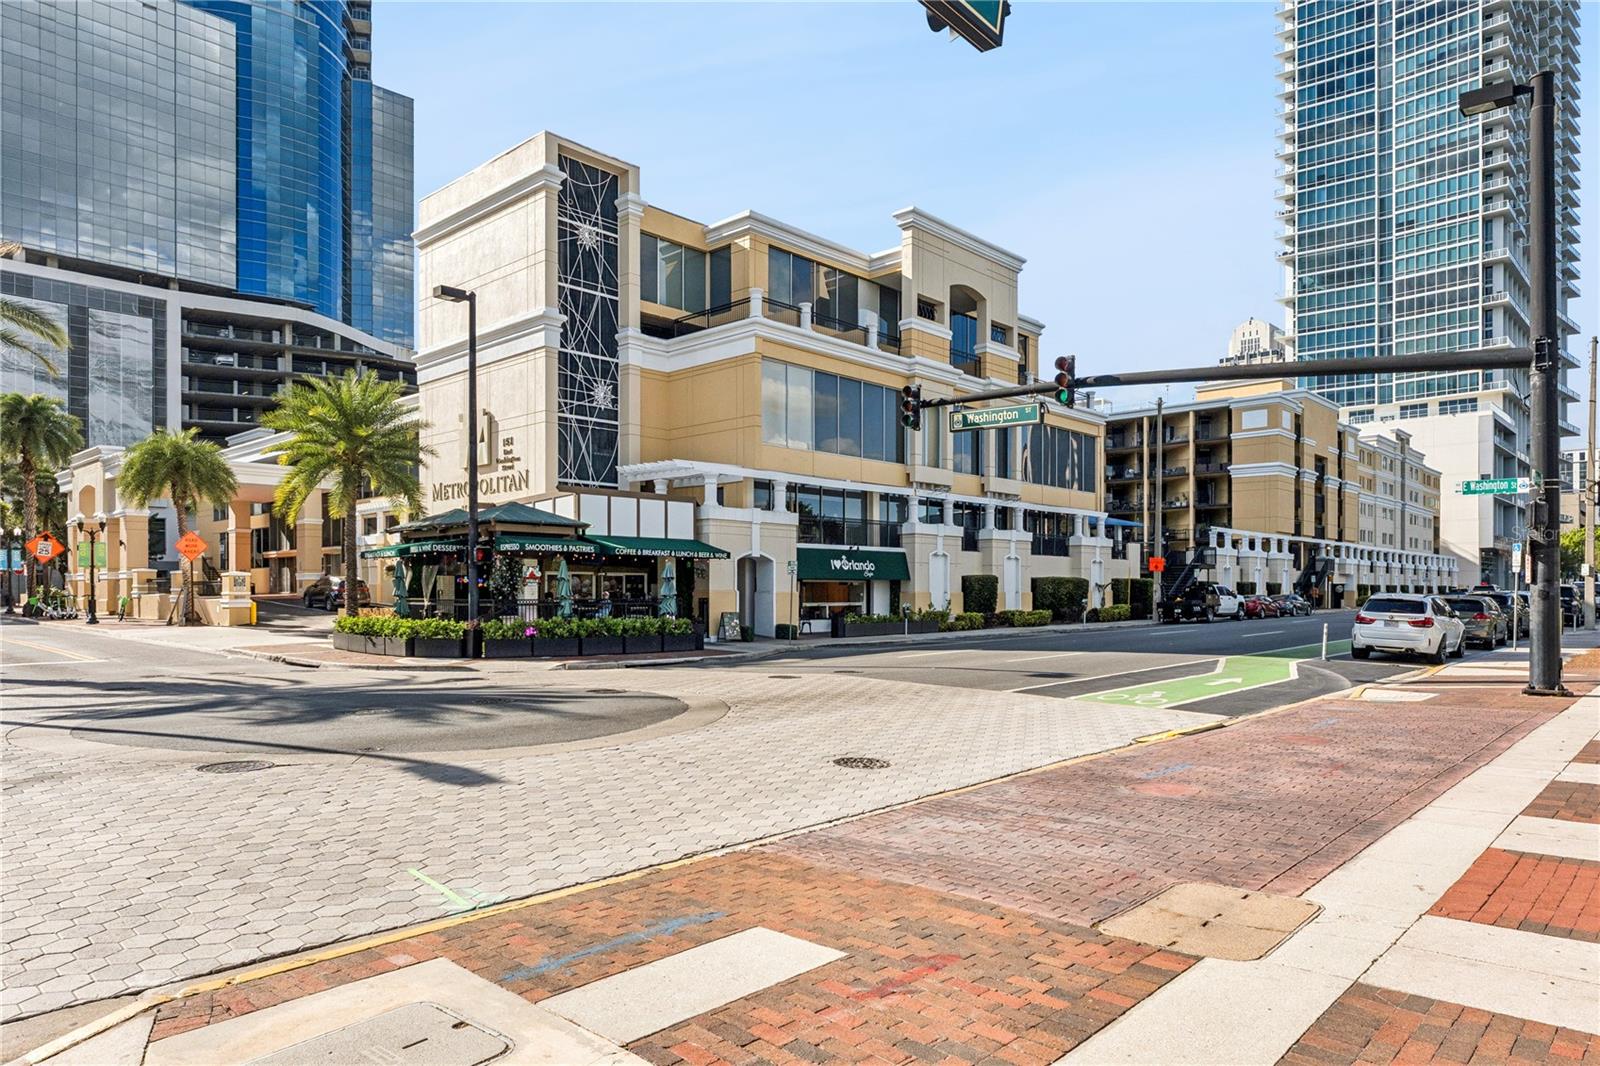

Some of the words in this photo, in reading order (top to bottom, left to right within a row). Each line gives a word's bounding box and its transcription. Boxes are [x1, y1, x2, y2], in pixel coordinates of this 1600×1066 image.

[966, 409, 1019, 424] Washington
[432, 469, 529, 502] METROOLITAN
[1463, 481, 1468, 492] E
[1470, 479, 1509, 493] Washington
[525, 543, 561, 552] SMOOTHIES
[568, 545, 595, 553] PASTRIES
[615, 547, 637, 555] COFFEE
[642, 549, 670, 557] BREAKFAST
[675, 550, 694, 558] LUNCH
[841, 556, 876, 571] Orlando
